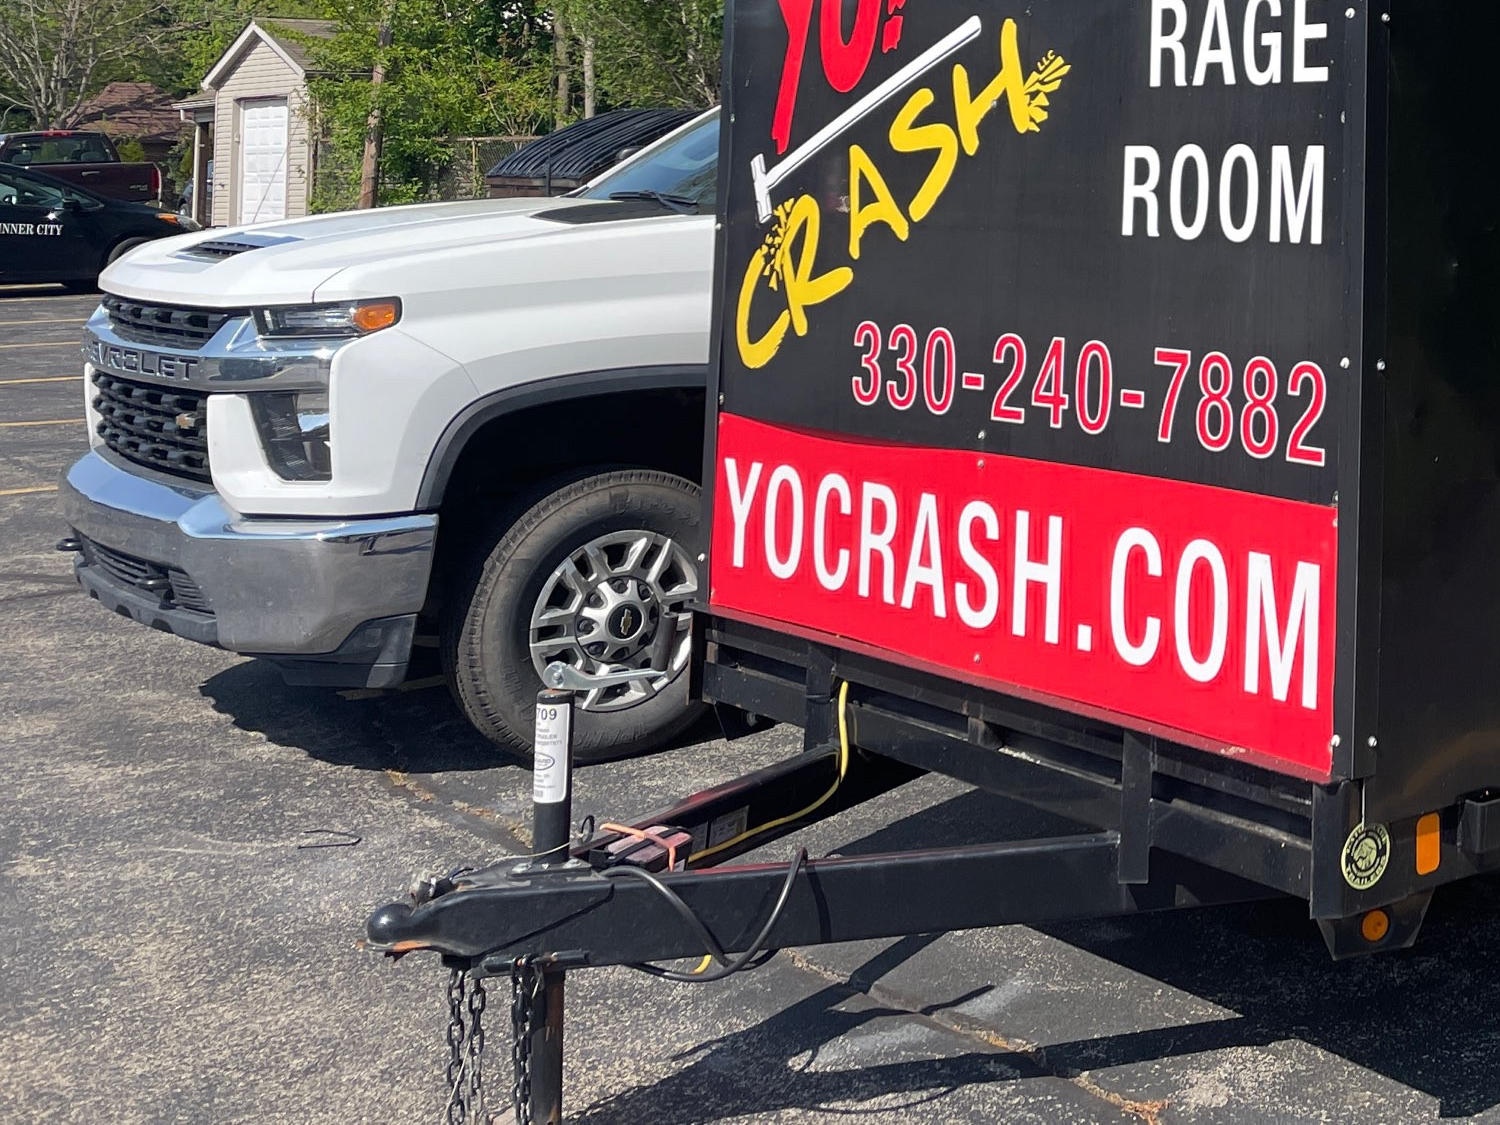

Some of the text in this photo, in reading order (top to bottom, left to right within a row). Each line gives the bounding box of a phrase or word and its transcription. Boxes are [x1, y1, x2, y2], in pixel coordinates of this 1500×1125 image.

[36, 224, 64, 236] CITY
[737, 19, 1071, 368] CRASH LLC
[1122, 144, 1324, 244] ROOM
[852, 321, 1326, 466] 330-240-7882
[725, 458, 1320, 709] YOCRASH.COM
